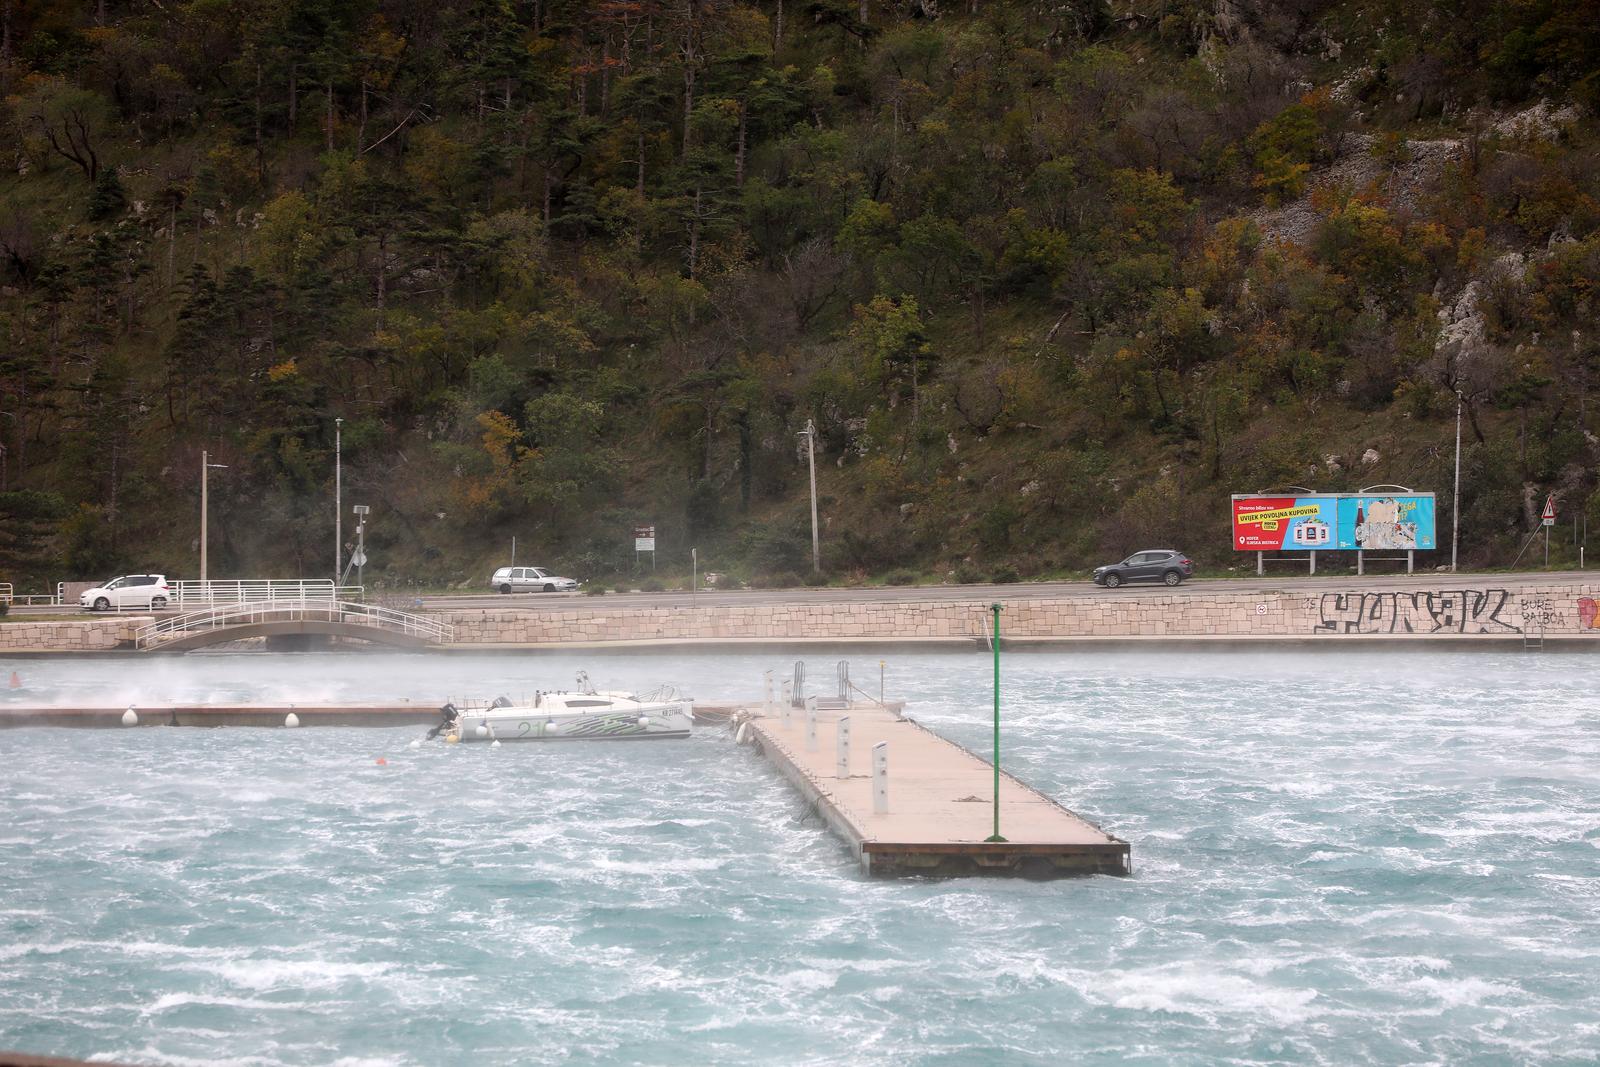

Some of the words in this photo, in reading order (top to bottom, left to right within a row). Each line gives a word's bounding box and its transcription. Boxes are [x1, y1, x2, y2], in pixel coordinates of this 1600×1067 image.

[1240, 514, 1258, 522] UVIJEK
[1260, 511, 1288, 519] POVOLJNA
[1289, 507, 1318, 516] KUPOVINA
